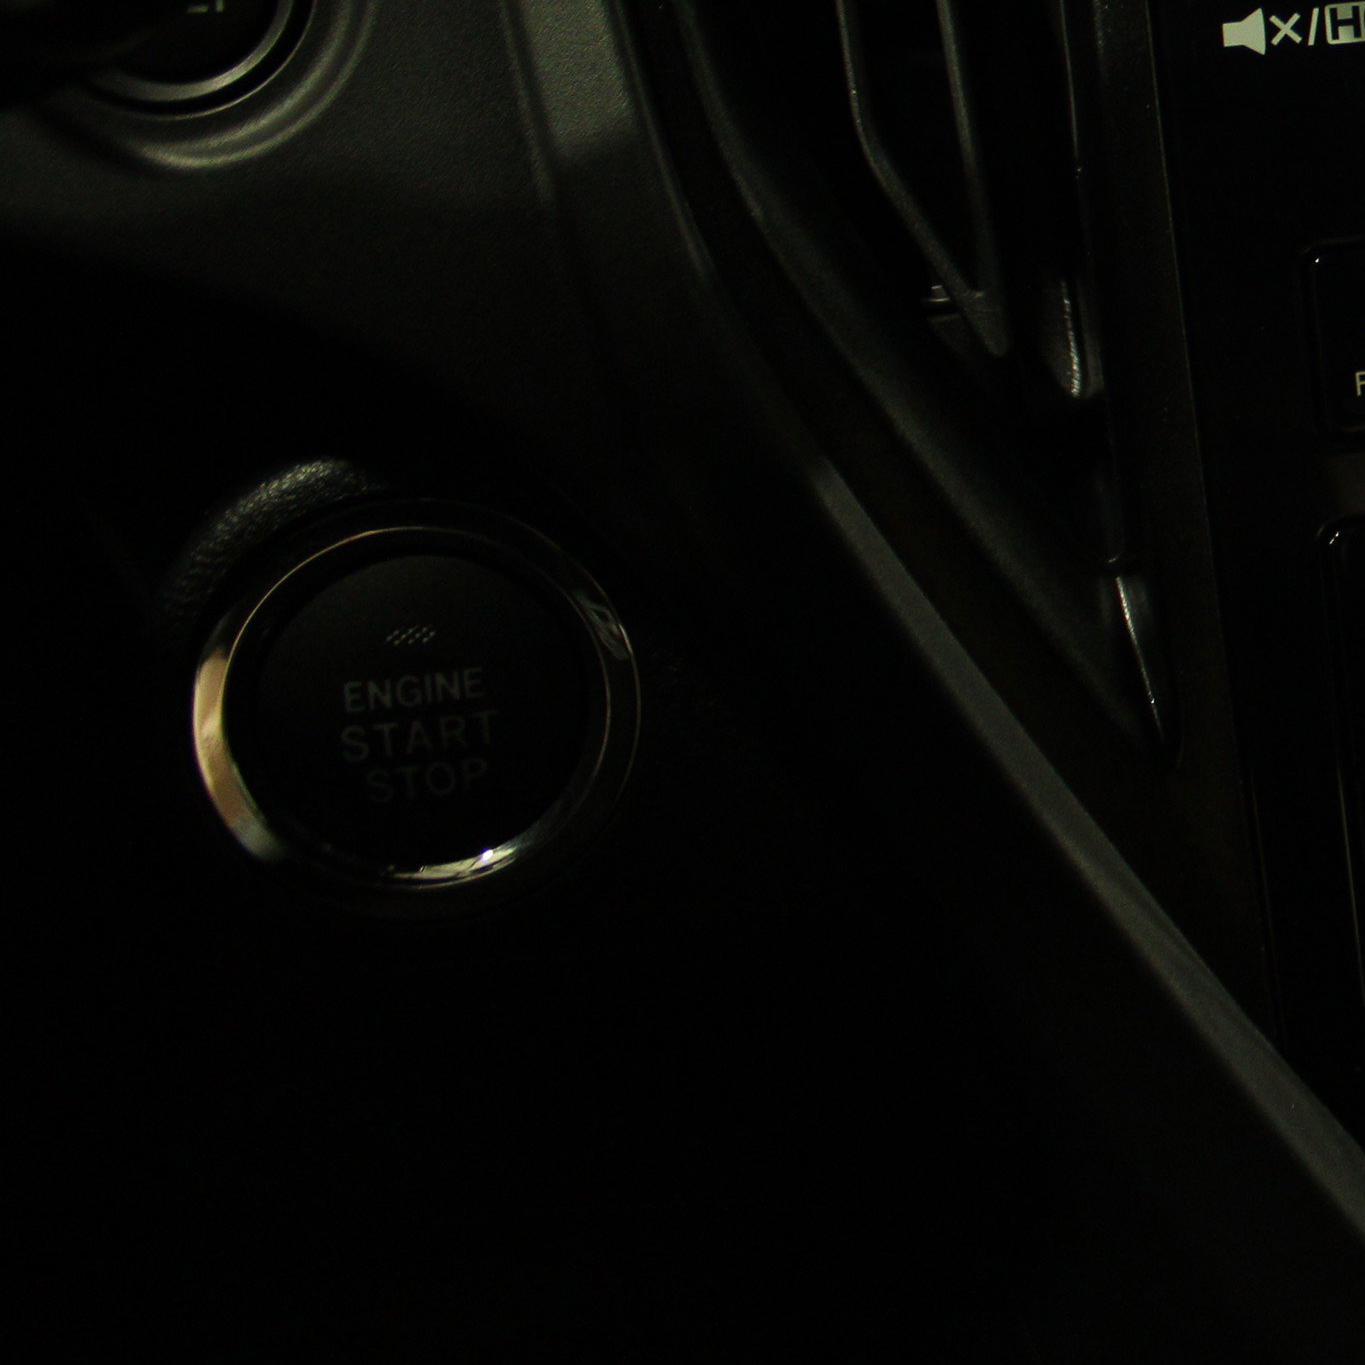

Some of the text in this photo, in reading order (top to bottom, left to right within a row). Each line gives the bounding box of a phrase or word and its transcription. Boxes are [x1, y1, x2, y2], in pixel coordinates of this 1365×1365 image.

[343, 667, 486, 713] ENGINE
[340, 708, 498, 763] START
[366, 757, 489, 803] STOP
